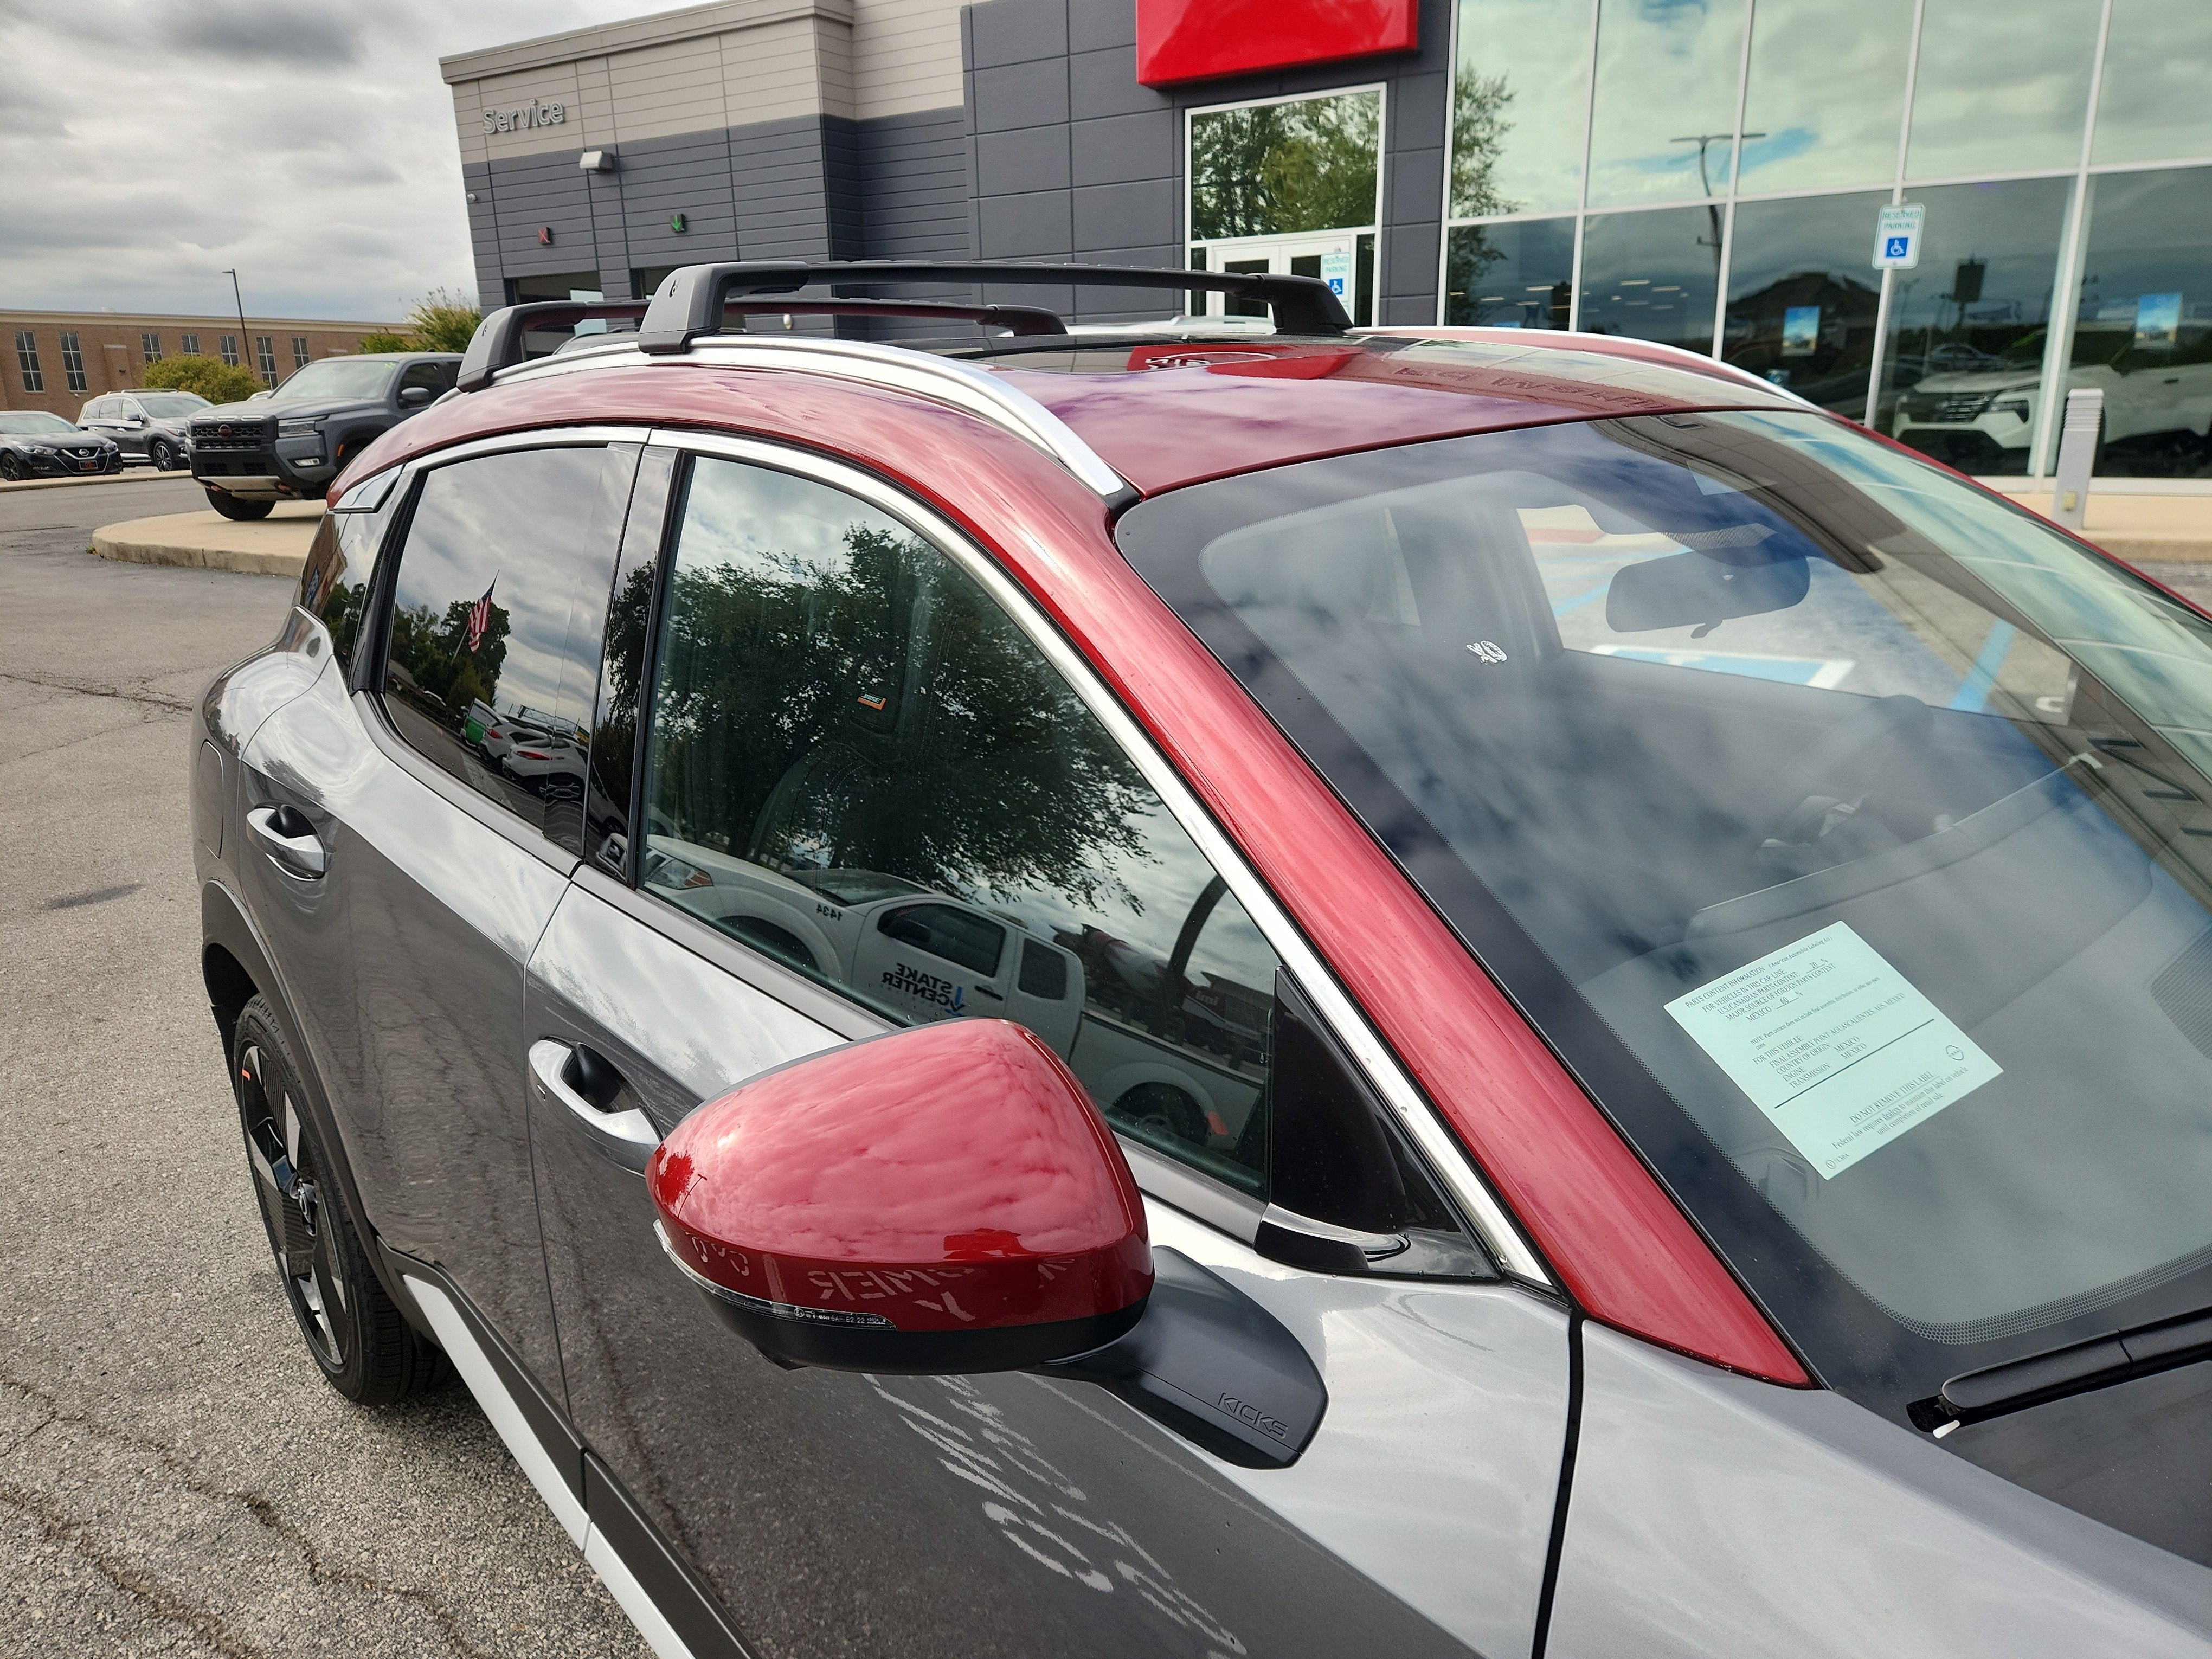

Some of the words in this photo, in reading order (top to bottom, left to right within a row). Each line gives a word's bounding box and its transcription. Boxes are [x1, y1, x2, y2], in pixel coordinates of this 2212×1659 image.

[482, 98, 564, 134] Service
[1882, 210, 1921, 220] RESERVED
[864, 693, 882, 703] BOSE
[1684, 995, 1705, 1008] PARTS
[1702, 982, 1730, 999] CONTENT
[1727, 966, 1766, 987] INFORMATION
[1788, 947, 1809, 960] Automobile
[1806, 940, 1825, 950] Labeling
[1701, 1003, 1717, 1013] FOR
[1713, 989, 1742, 1006] VEHICLES
[1746, 980, 1761, 991] THIS
[1759, 975, 1773, 984] CAR
[1770, 968, 1787, 979] LINE:
[1717, 991, 1759, 1015] U.S./CANADIAN
[1756, 983, 1776, 995] PARTS
[1725, 1007, 1748, 1021] MAJOR
[1744, 996, 1769, 1011] SOURCE
[1766, 992, 1776, 1000] OF
[1773, 981, 1798, 997] FOREIGN
[1795, 974, 1814, 986] PARTS
[1745, 1006, 1772, 1023] MEXICO
[1780, 996, 1791, 1006] 60
[1752, 1054, 1767, 1065] FOR
[1764, 1047, 1780, 1058] THIS
[1776, 1035, 1804, 1051] VEHICLE:
[1769, 1055, 1789, 1068] FINAL
[1786, 1040, 1815, 1060] ASSEMBLY
[1776, 1056, 1804, 1075] COUNTRY
[1801, 1052, 1811, 1060] OF
[1782, 1066, 1806, 1082] ENGINE:
[1833, 1036, 1860, 1053] MEXICO
[1788, 1063, 1831, 1089] TRANSMISSION:
[1840, 1043, 1867, 1060] MEXICO
[1831, 1133, 1855, 1150] Federal
[1850, 1129, 1864, 1138] law
[1862, 1117, 1885, 1132] requires
[1881, 1107, 1902, 1121] dealers
[1904, 1091, 1927, 1107] maintain
[1923, 1086, 1936, 1095] this
[1931, 1078, 1947, 1089] label
[1950, 1066, 1969, 1078] vehicle
[1849, 1113, 1862, 1123] DO
[1859, 1105, 1876, 1117] NOT
[1873, 1090, 1901, 1109] REMOVE
[1899, 1081, 1917, 1094] THIS
[1874, 1123, 1891, 1135] until
[1888, 1109, 1917, 1128] completion
[1919, 1097, 1935, 1109] retail
[1217, 1392, 1289, 1439] KICKS
